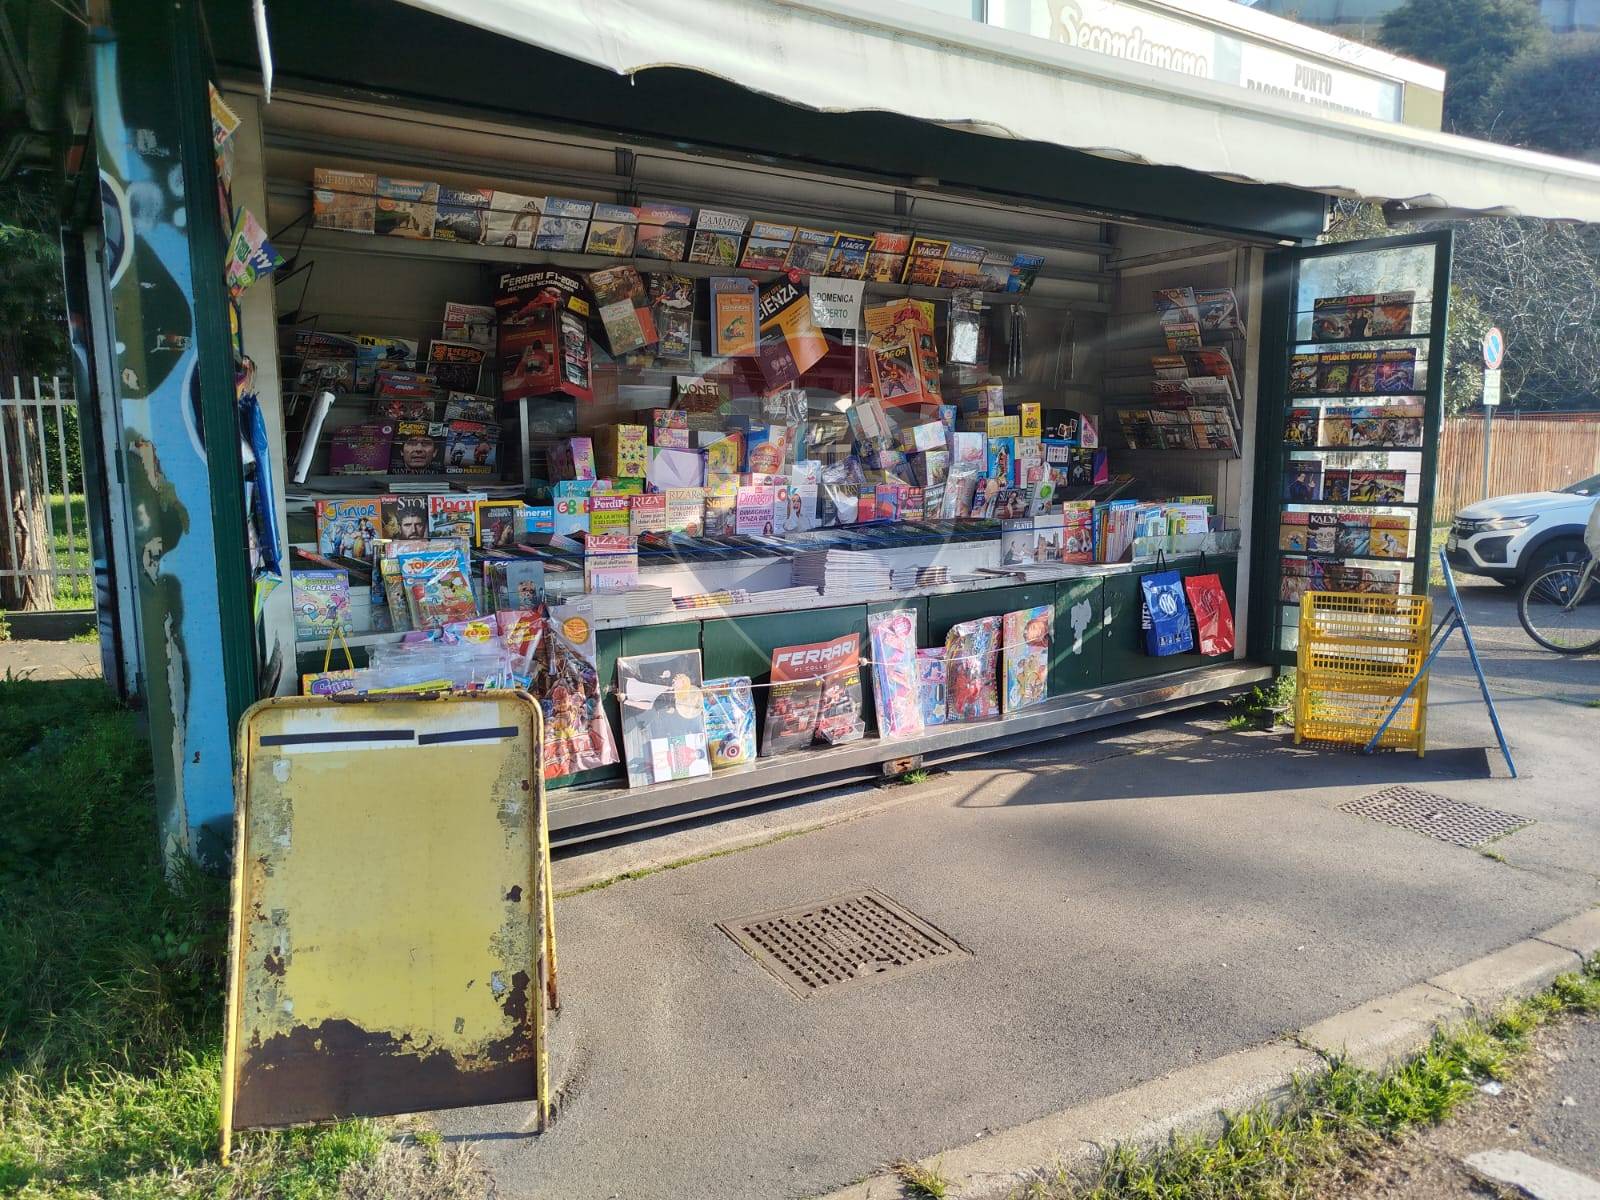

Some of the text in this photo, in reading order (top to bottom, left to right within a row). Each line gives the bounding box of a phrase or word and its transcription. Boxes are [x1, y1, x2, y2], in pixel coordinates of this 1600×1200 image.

[1059, 4, 1208, 80] Secondamano
[1293, 63, 1333, 97] PUNTO
[840, 239, 866, 250] VIAGGI
[917, 246, 942, 257] VIAGGI
[500, 271, 580, 290] FERRARI F1-2000
[759, 283, 799, 321] IENZA
[816, 292, 854, 304] DOMENICA
[361, 336, 376, 346] IN
[878, 347, 909, 361] ZAGOR
[678, 383, 719, 396] MONET
[632, 496, 660, 508] RIZA
[587, 536, 618, 548] RIZA
[774, 640, 857, 669] FERRARI
